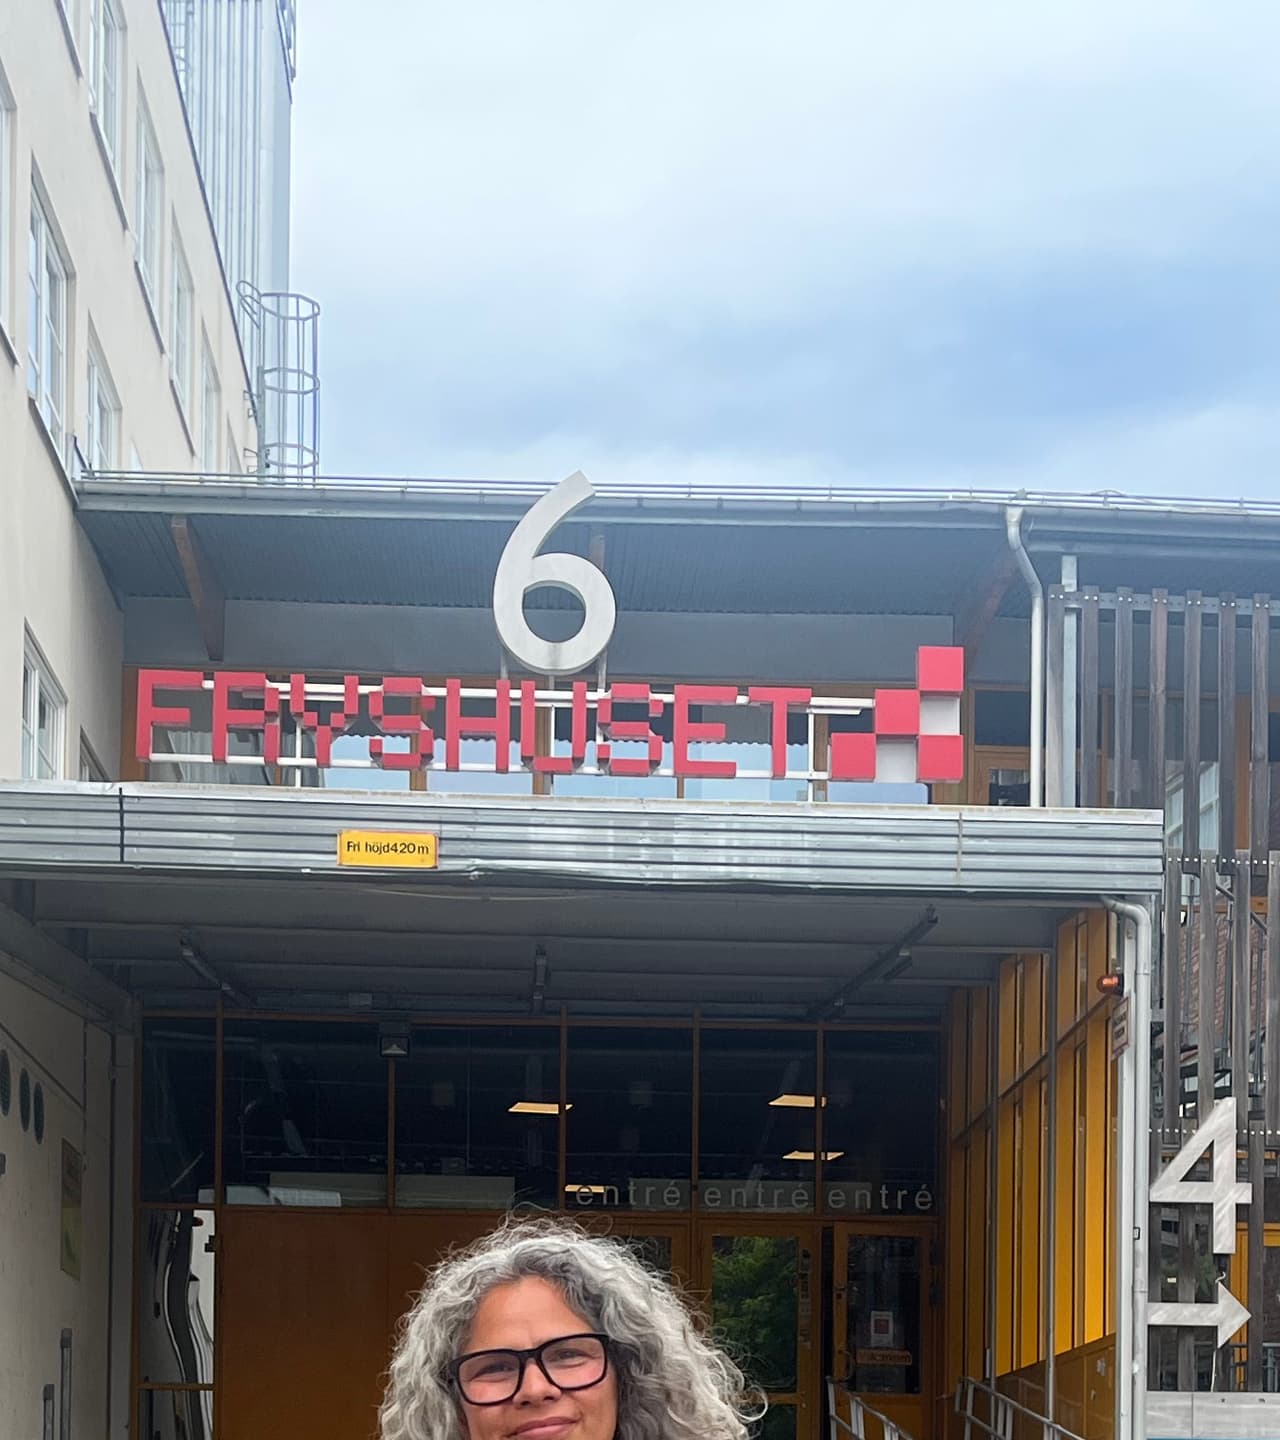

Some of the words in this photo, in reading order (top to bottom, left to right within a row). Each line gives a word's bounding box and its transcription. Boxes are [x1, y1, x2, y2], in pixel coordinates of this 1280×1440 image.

[493, 470, 616, 675] 6
[136, 669, 812, 780] FRYSHUSET
[575, 1180, 682, 1206] entré
[704, 1182, 809, 1208] entré
[827, 1184, 933, 1211] entré
[1150, 1097, 1252, 1254] 4
